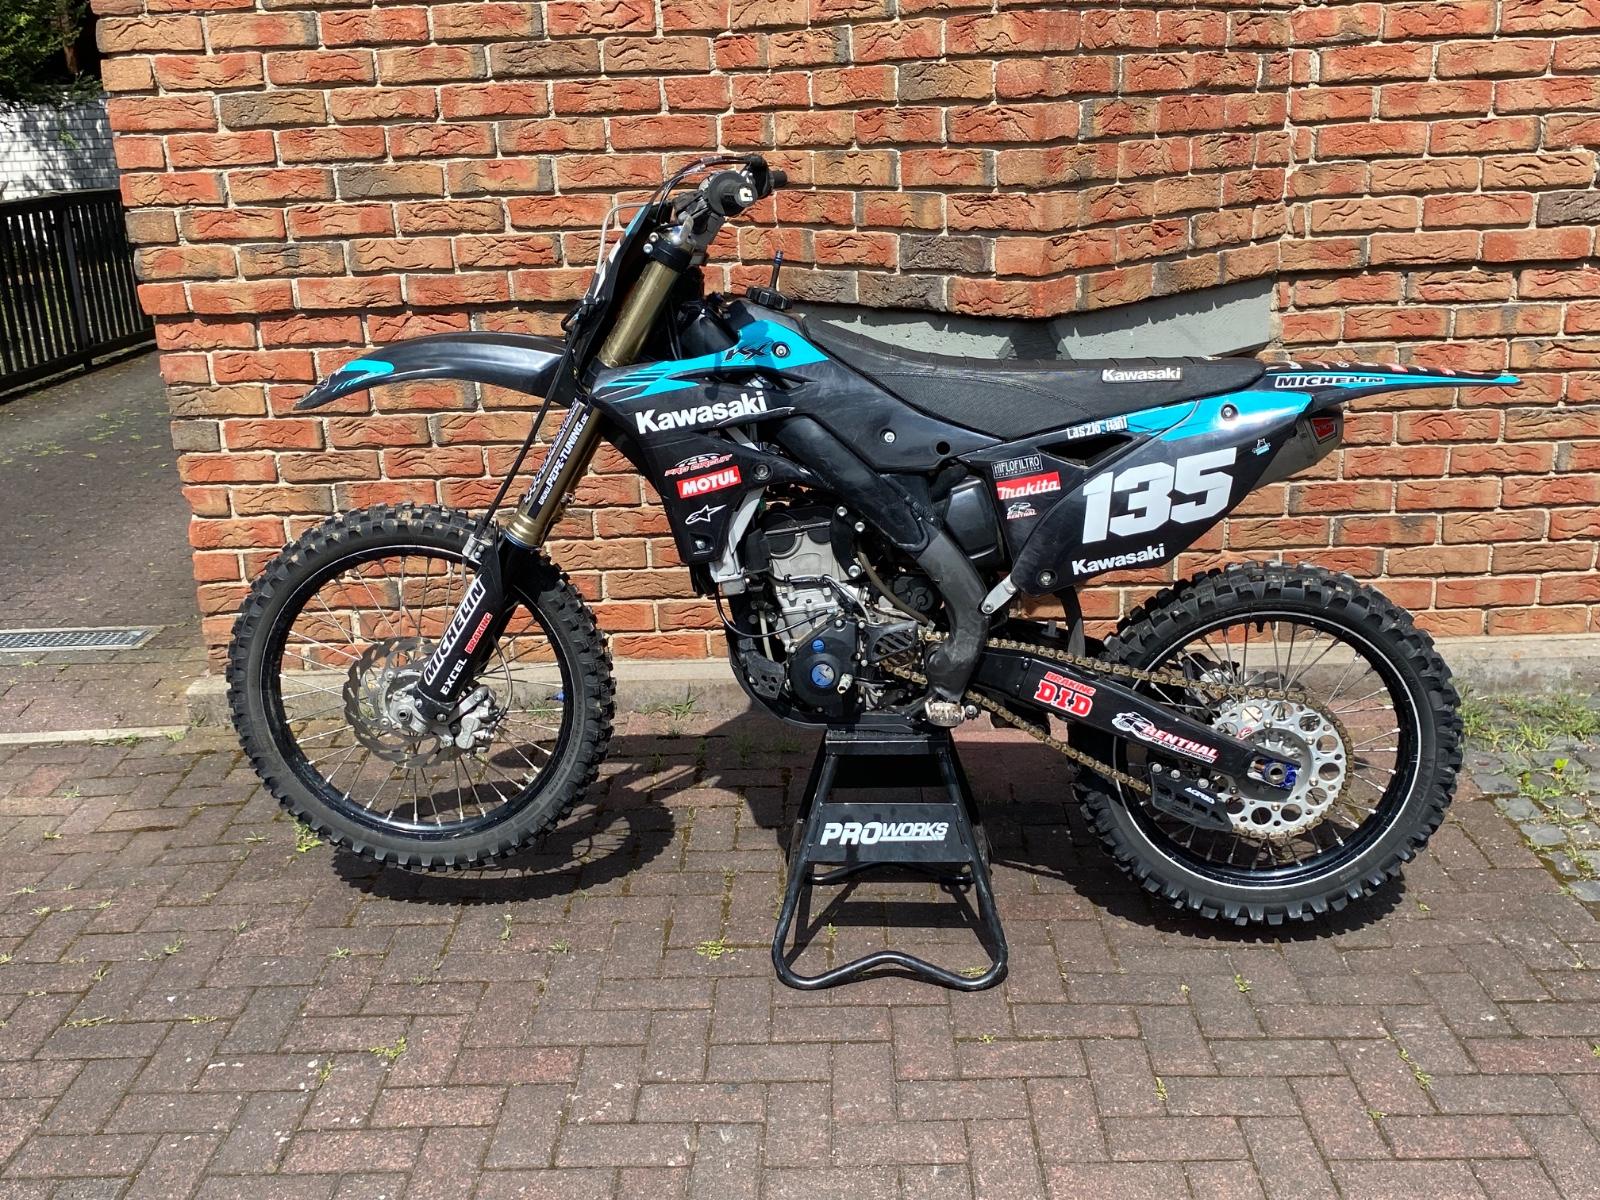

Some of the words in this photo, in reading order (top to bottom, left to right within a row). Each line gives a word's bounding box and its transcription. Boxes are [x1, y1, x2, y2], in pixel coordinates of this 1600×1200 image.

[724, 340, 774, 362] KX
[1102, 367, 1181, 381] Kawasaki
[1275, 375, 1386, 388] MICHELIN
[635, 391, 768, 434] Kawasaki
[993, 456, 1040, 475] HIFLOFILTRO
[682, 470, 738, 496] MOTUL
[1082, 447, 1237, 545] 135
[1072, 543, 1165, 576] Kawasaki
[424, 576, 486, 686] MICHELIN
[465, 613, 493, 655] BRAKING
[440, 658, 467, 696] EXCEL
[1044, 671, 1096, 697] BRAKING
[1142, 724, 1219, 759] RENTHAL
